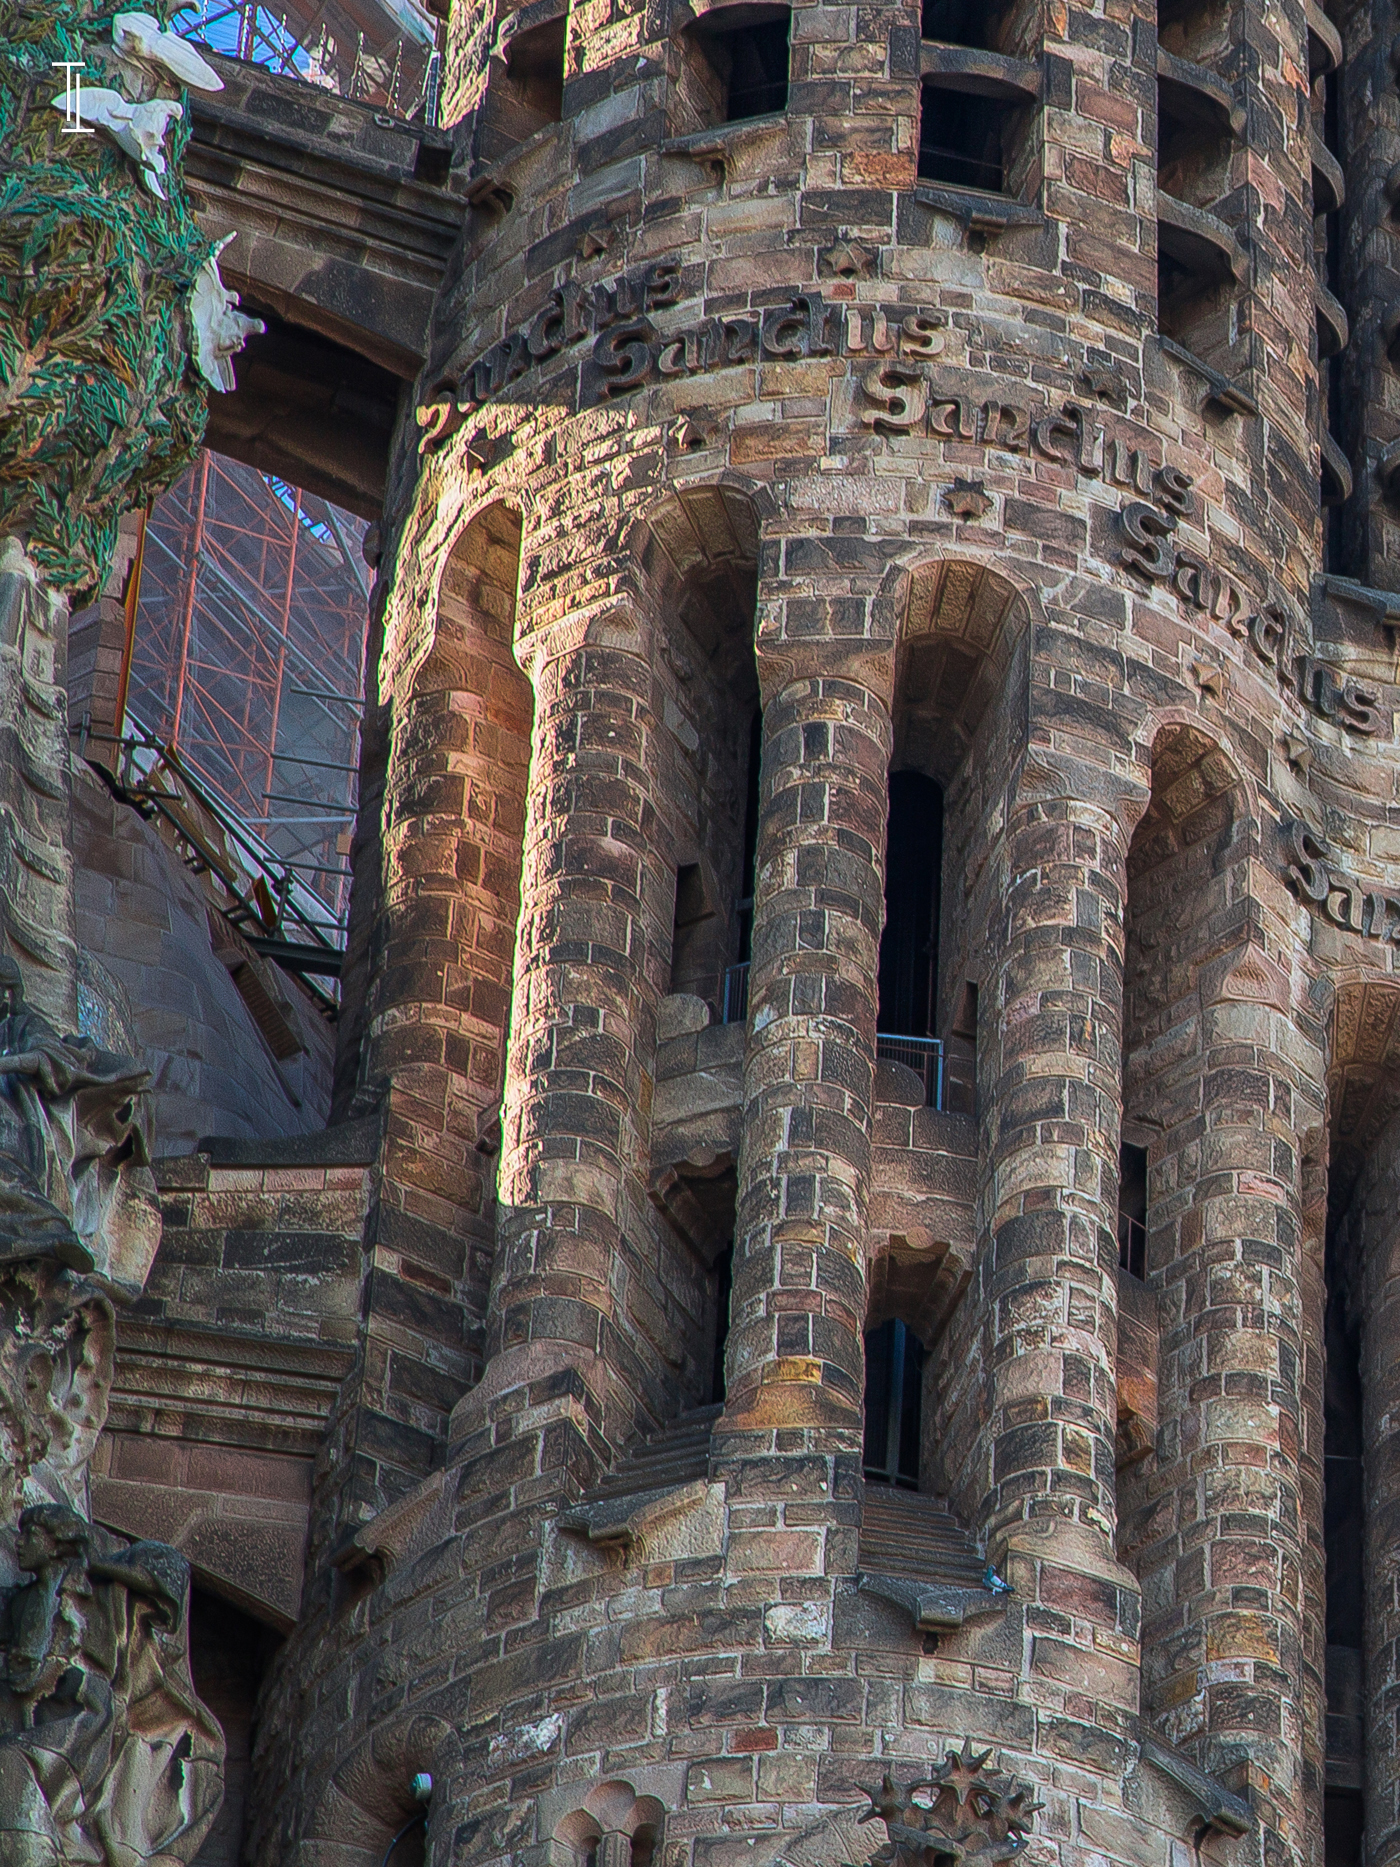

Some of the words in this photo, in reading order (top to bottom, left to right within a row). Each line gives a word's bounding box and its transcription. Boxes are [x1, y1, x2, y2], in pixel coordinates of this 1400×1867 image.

[592, 296, 947, 398] Sanctus
[860, 363, 1195, 516] Sanctus
[1121, 501, 1382, 734] Sanctus
